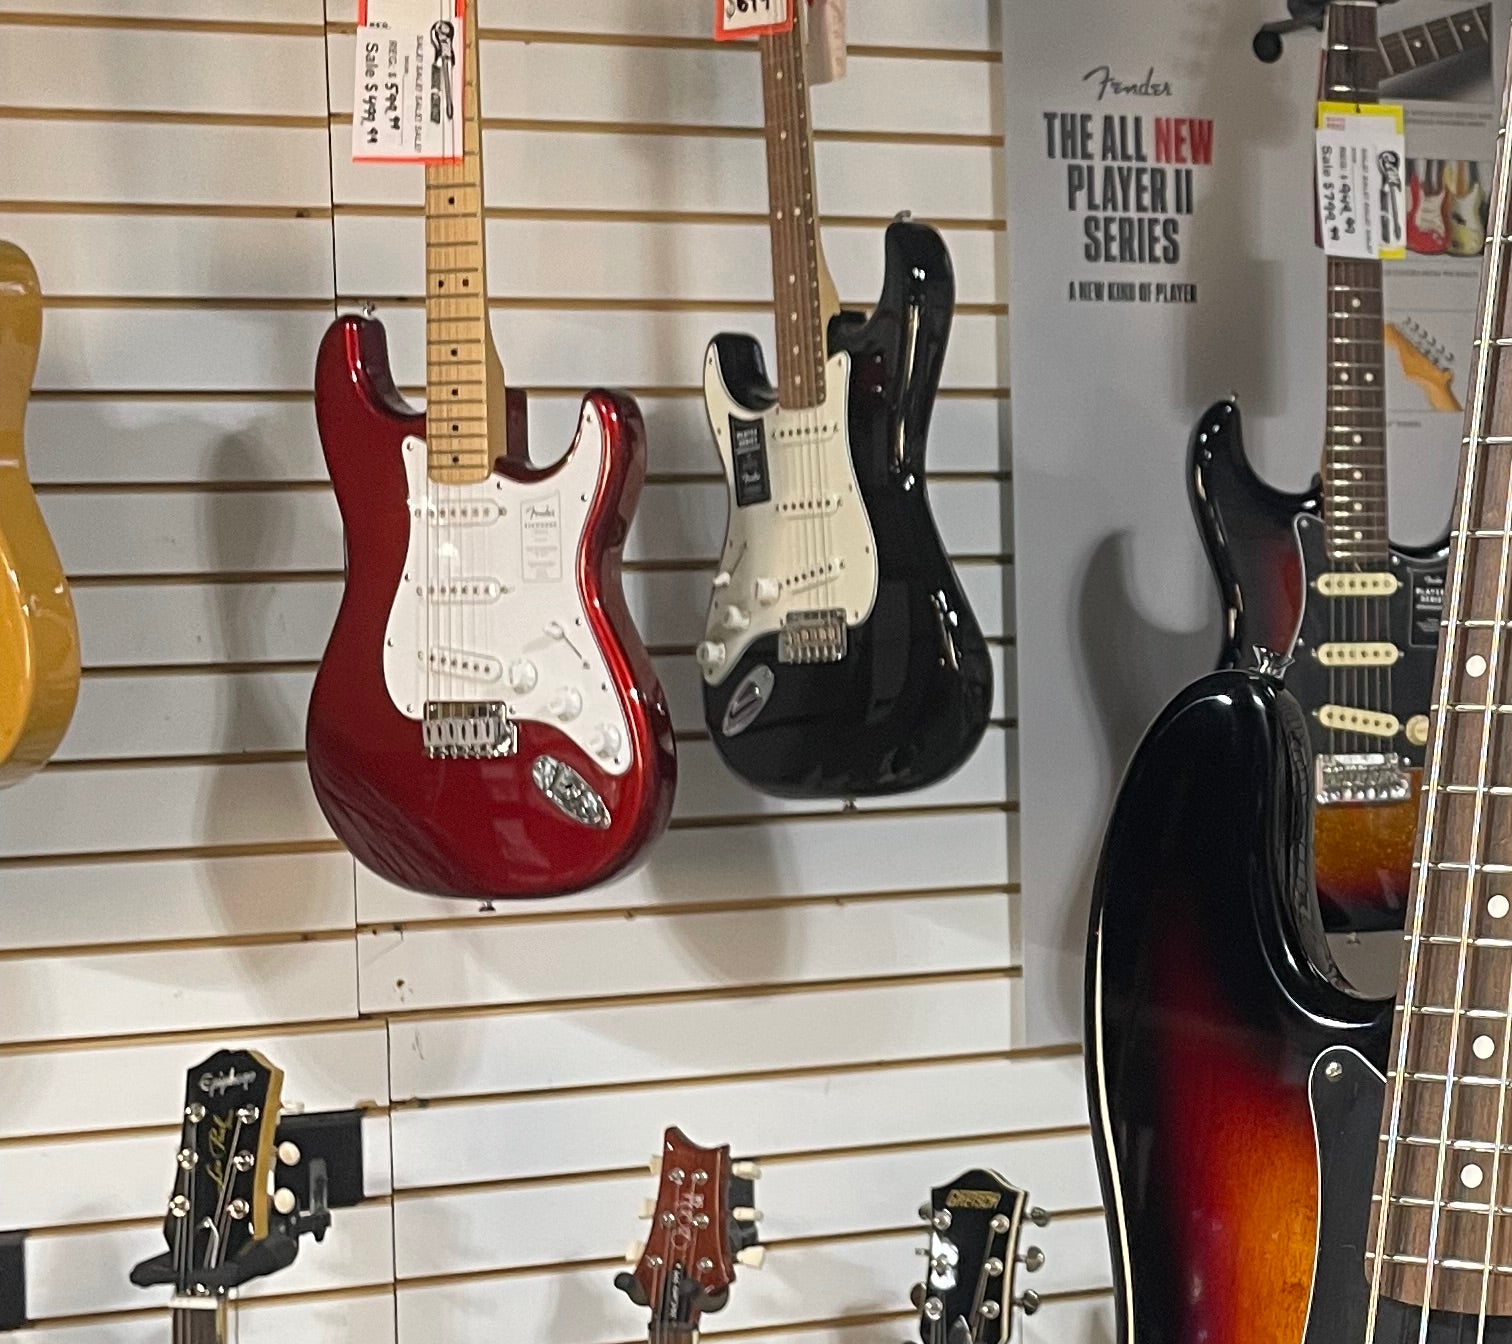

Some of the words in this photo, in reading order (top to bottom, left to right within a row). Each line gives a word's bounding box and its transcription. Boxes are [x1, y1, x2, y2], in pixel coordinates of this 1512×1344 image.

[365, 42, 379, 78] Sale
[1083, 65, 1172, 101] Fender
[1043, 112, 1095, 160] THE
[1102, 115, 1148, 162] ALL
[1153, 117, 1214, 164] NEW
[1067, 164, 1166, 213] PLAYER
[1174, 168, 1194, 214] II
[1084, 215, 1180, 264] SERIES
[1069, 281, 1077, 302] A
[1079, 281, 1105, 302] NEW
[1139, 282, 1152, 302] OF
[1156, 282, 1198, 303] PLAYER
